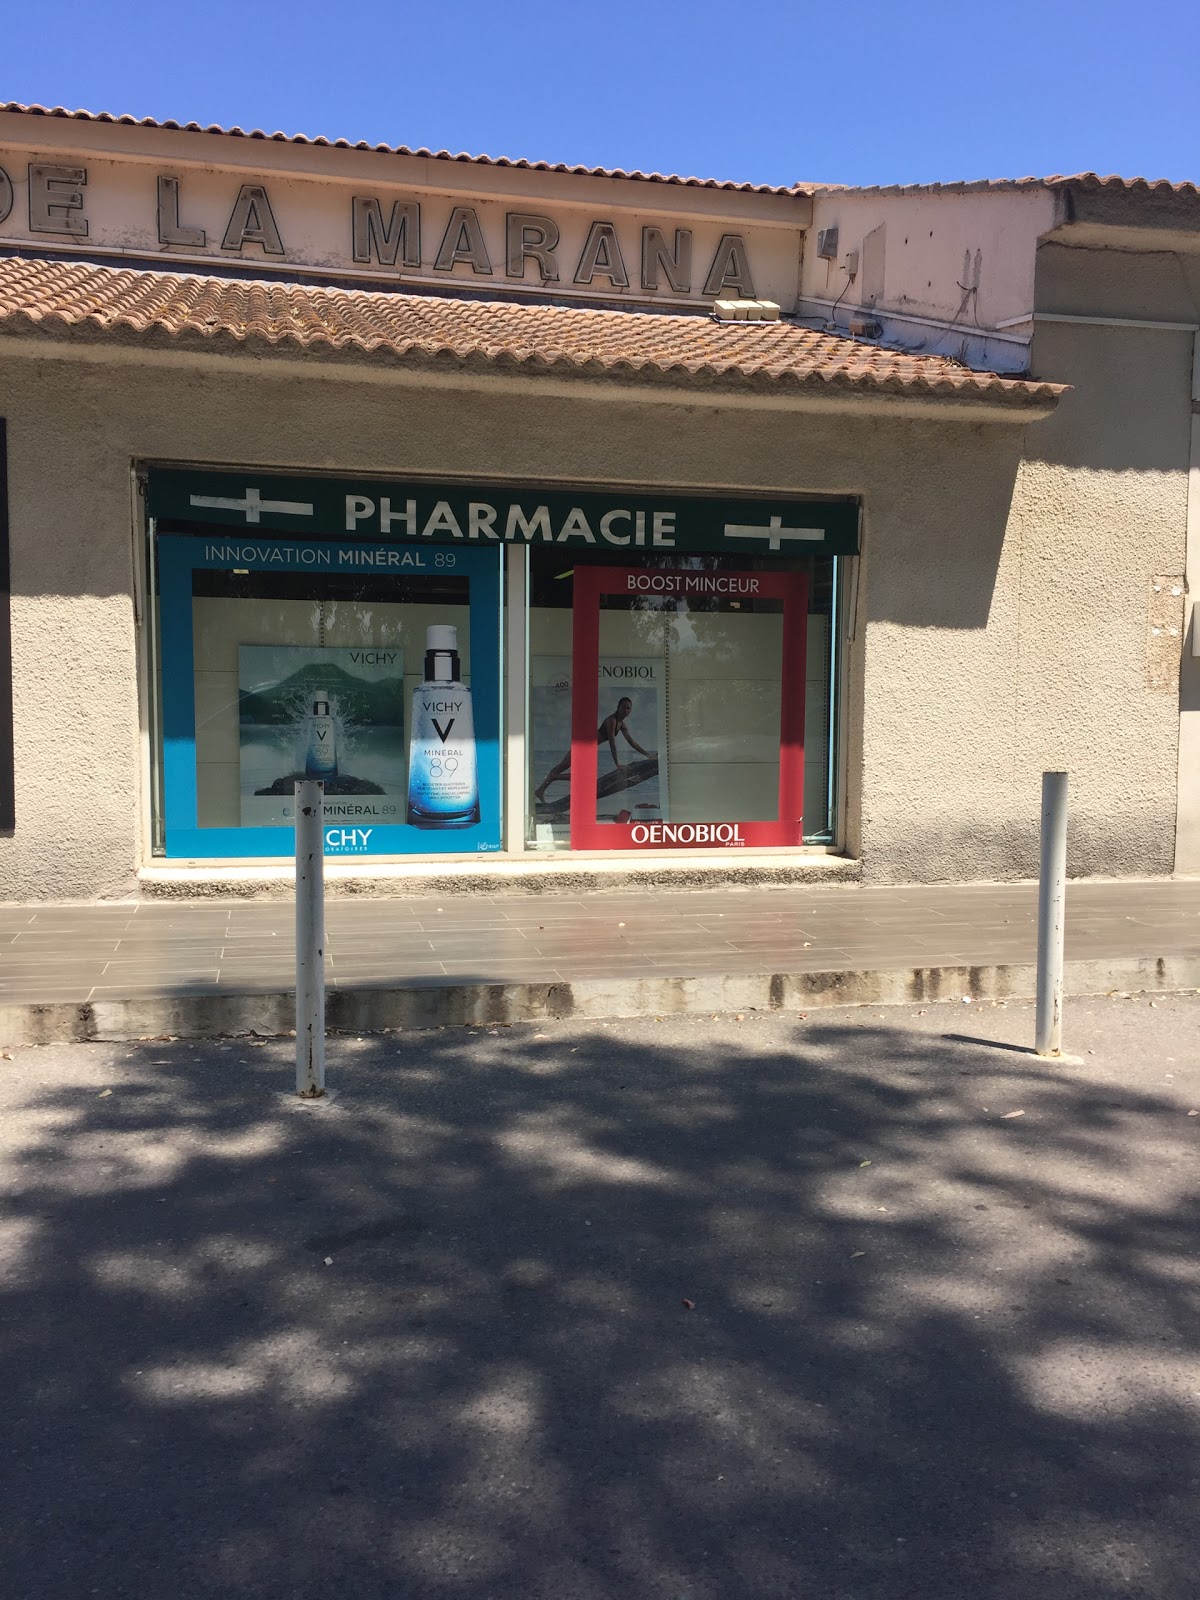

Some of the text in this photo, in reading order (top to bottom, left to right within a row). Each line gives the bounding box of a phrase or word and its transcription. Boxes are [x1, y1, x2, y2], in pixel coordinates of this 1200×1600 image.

[0, 163, 757, 299] E LA MARANA
[345, 494, 677, 547] PHARMACIE
[205, 545, 456, 568] INNOVATION MINÉRAL 89
[627, 574, 760, 593] BOOST MINCEUR
[349, 652, 398, 665] VICHY
[422, 701, 463, 712] VICHY
[316, 730, 327, 742] V
[431, 718, 456, 744] V
[430, 757, 459, 778] 89
[323, 803, 397, 815] MINÉRAL 89
[325, 828, 373, 846] CHY
[631, 823, 746, 844] OENOBIOL
